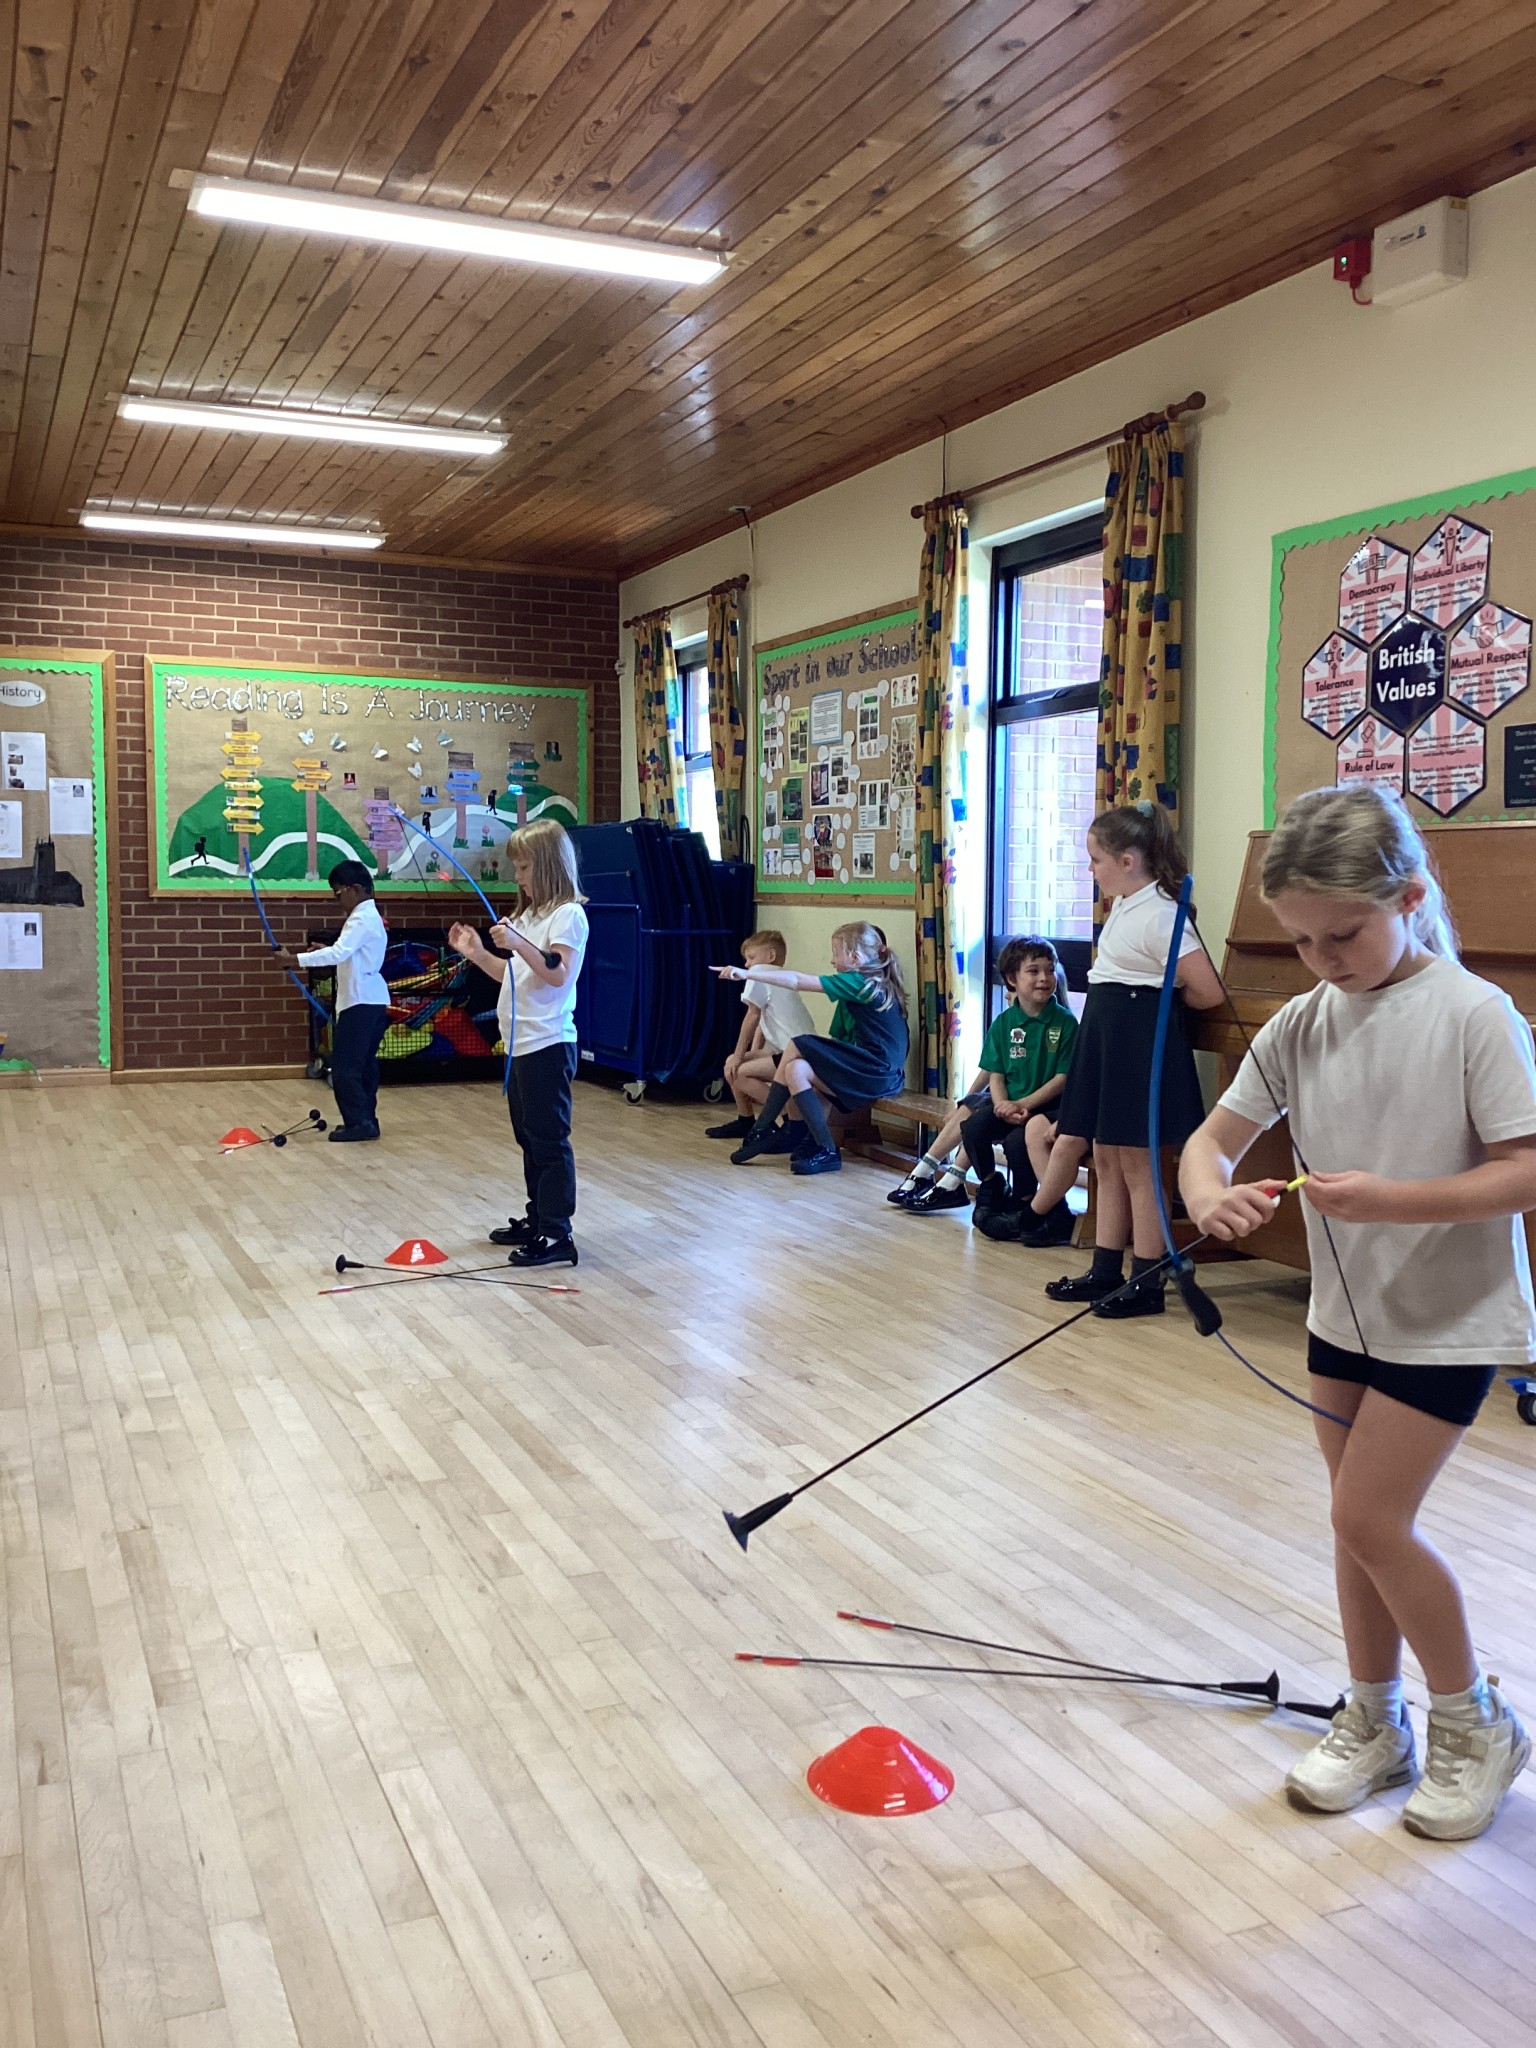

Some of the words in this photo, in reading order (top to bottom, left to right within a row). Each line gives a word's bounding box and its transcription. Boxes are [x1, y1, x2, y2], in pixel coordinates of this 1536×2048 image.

[1456, 560, 1487, 574] Liberty
[1349, 581, 1397, 600] Democracy
[763, 661, 801, 696] Sport
[805, 654, 821, 684] in
[826, 651, 853, 678] our
[857, 625, 920, 674] School
[1379, 644, 1435, 670] British
[1450, 653, 1484, 669] Mutual
[1486, 648, 1527, 664] Respect
[1315, 679, 1354, 692] Tolerance
[1376, 681, 1436, 703] Values
[164, 675, 304, 719] Reading
[319, 682, 349, 715] Is
[365, 686, 394, 719] A
[409, 690, 536, 729] Journey
[1345, 761, 1363, 772] Rule
[1365, 760, 1374, 771] of
[1375, 760, 1395, 770] Law
